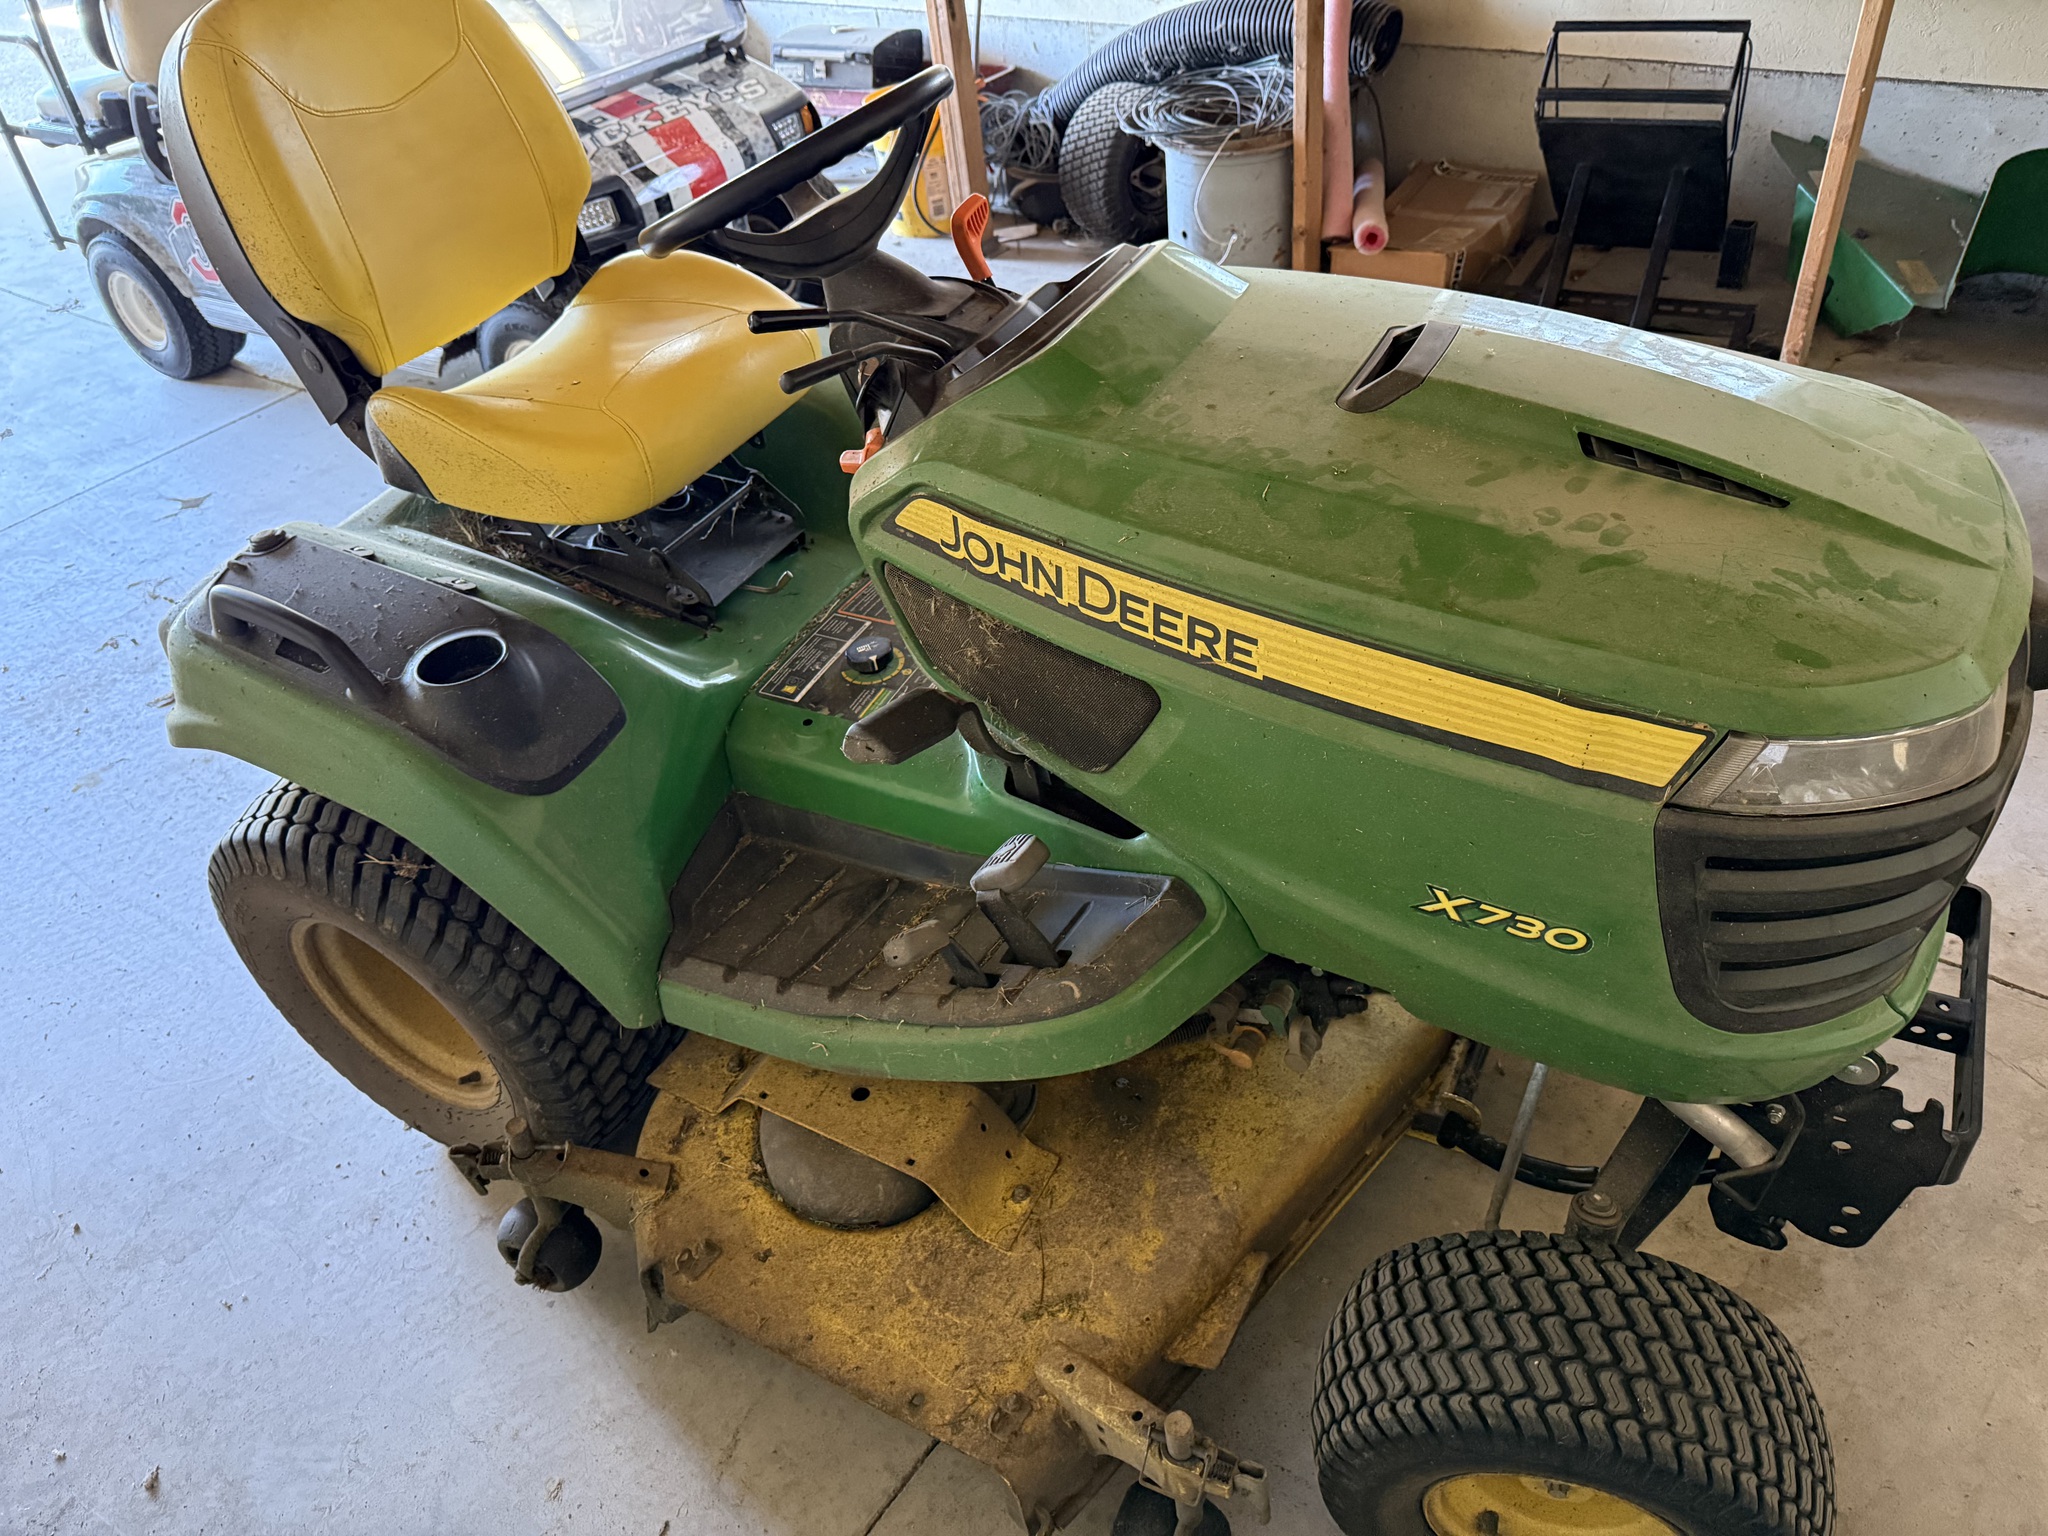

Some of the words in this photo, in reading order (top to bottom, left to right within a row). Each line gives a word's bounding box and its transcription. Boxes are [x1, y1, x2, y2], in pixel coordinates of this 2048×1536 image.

[940, 515, 1063, 599] JOHN
[1078, 566, 1259, 673] DEERE
[1414, 886, 1590, 952] X730
